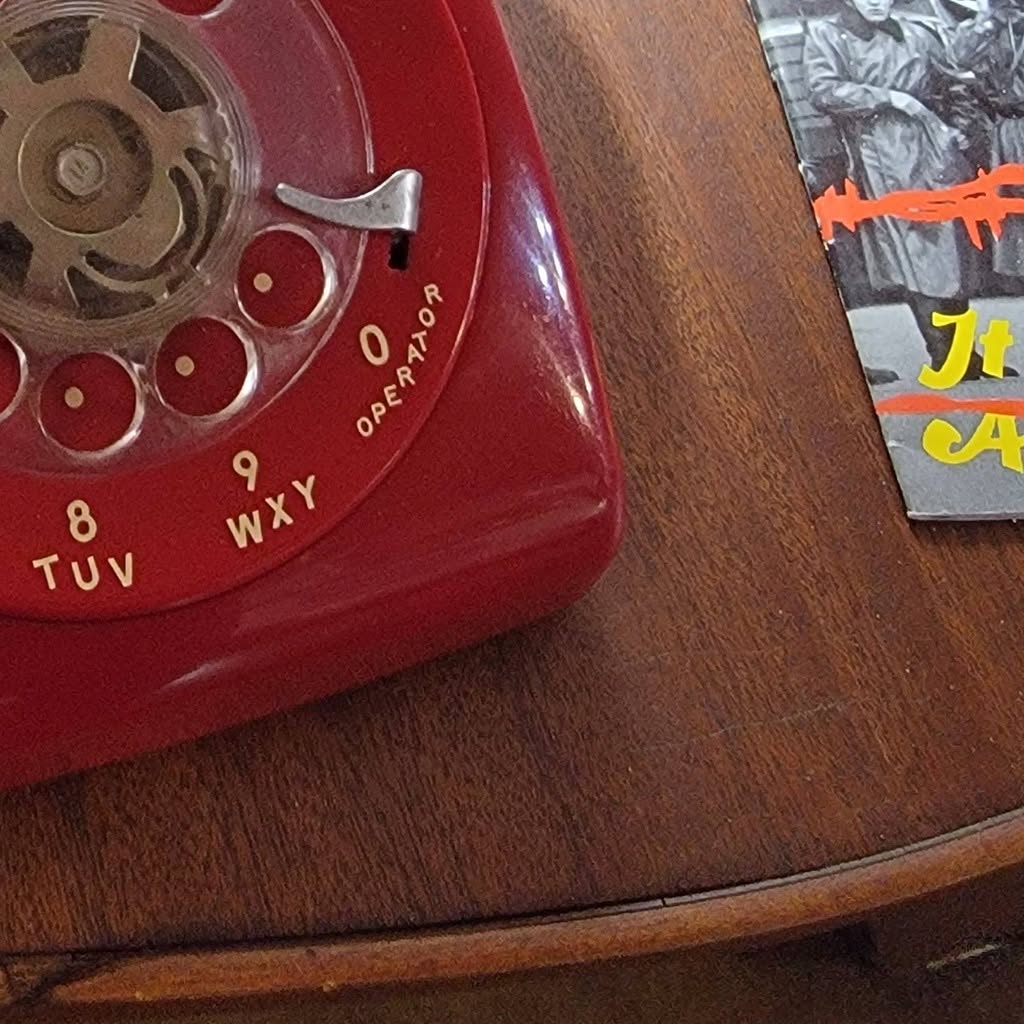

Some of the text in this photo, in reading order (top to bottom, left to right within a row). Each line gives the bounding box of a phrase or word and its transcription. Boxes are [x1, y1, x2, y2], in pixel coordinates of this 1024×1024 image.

[356, 283, 443, 437] OPERATOR
[359, 324, 389, 366] 0
[232, 450, 258, 492] 9
[66, 499, 97, 543] 8
[226, 475, 317, 549] WXY
[32, 552, 134, 591] TUV
